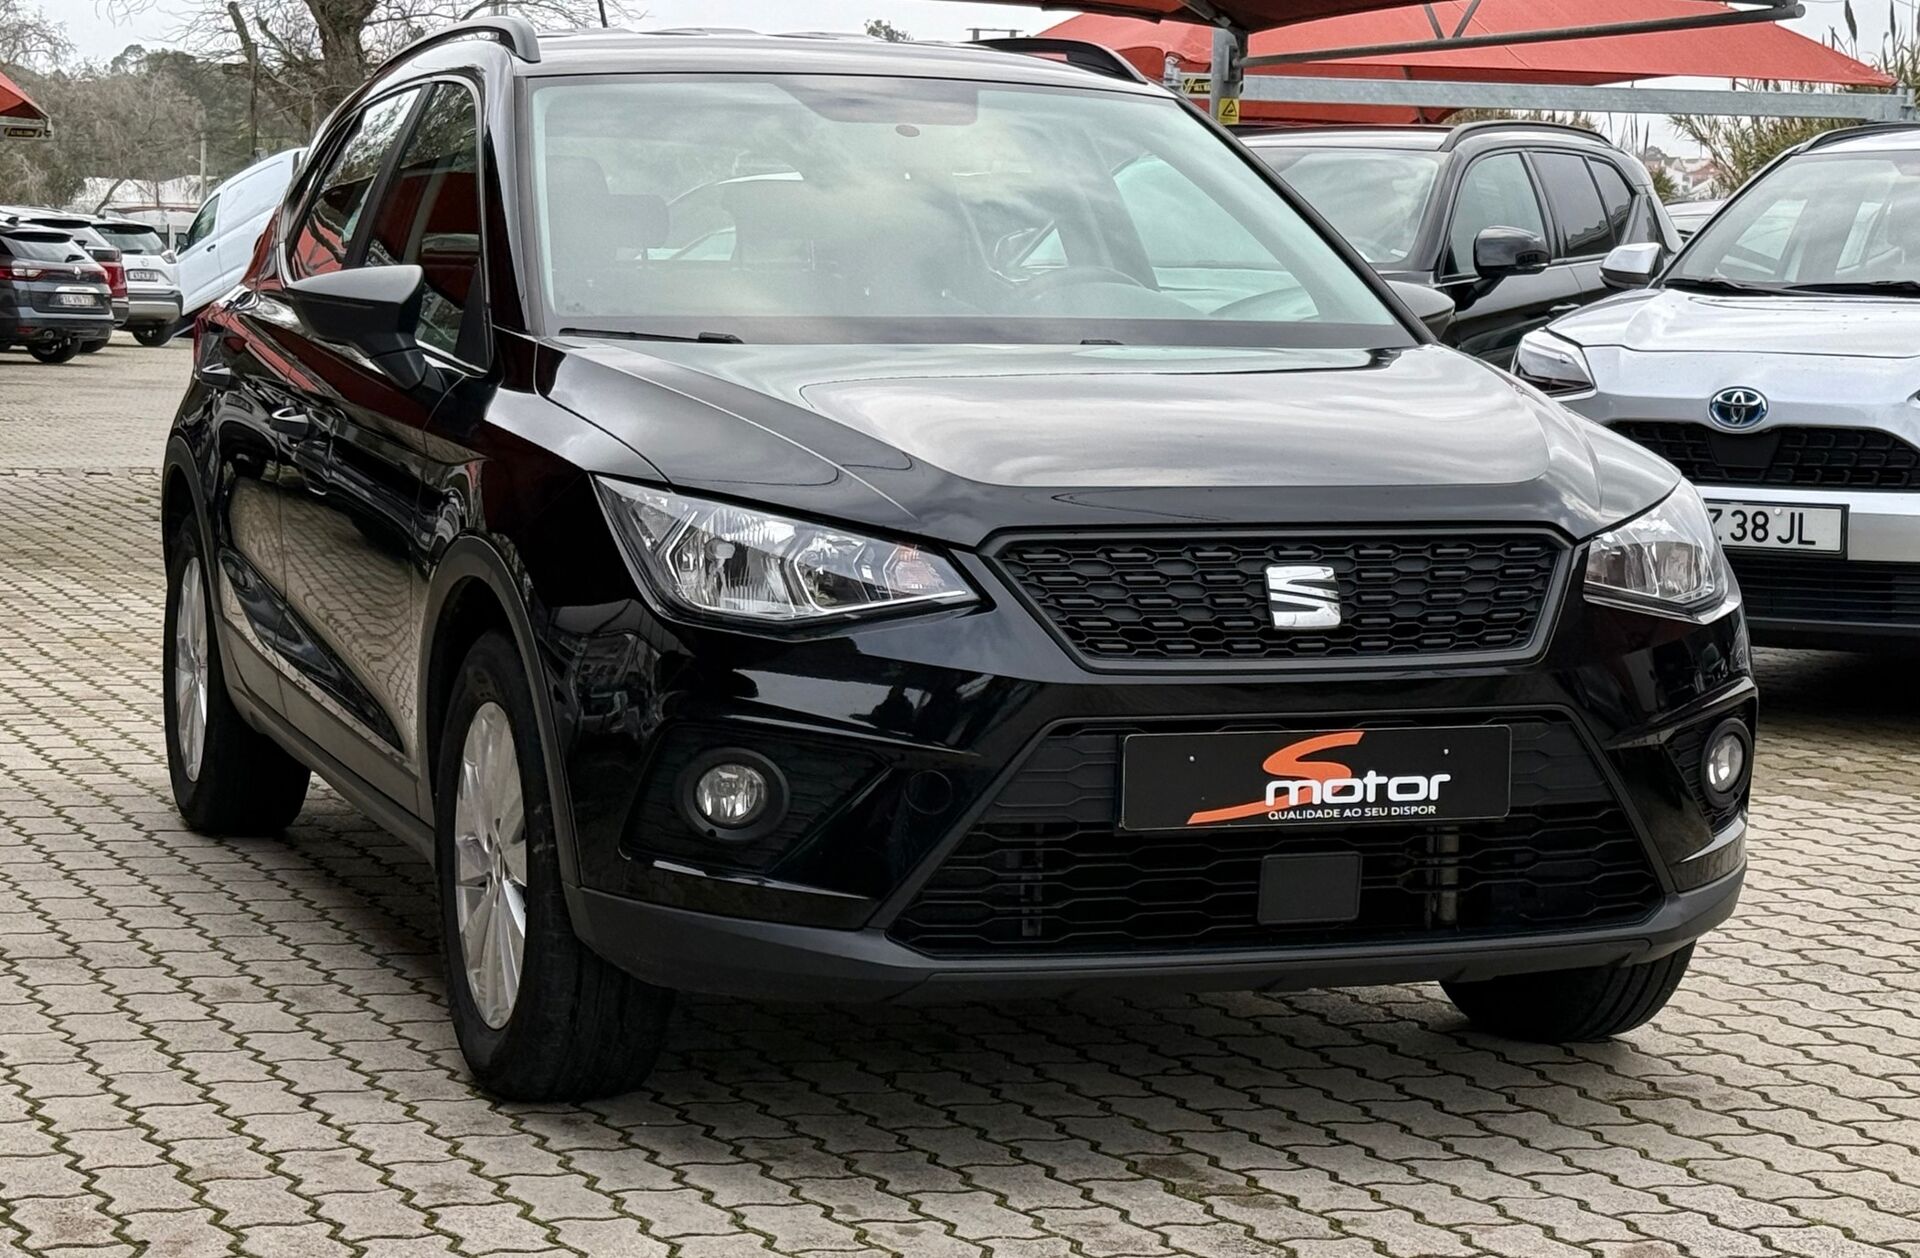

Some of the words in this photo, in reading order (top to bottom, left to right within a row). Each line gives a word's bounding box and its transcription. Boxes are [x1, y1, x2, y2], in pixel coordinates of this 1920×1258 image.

[1730, 510, 1769, 543] 38
[1776, 512, 1816, 545] JL
[1268, 809, 1341, 820] QUALIDADE
[1343, 807, 1362, 818] AO
[1364, 807, 1388, 817] SEU
[1391, 805, 1436, 816] DISPOR
